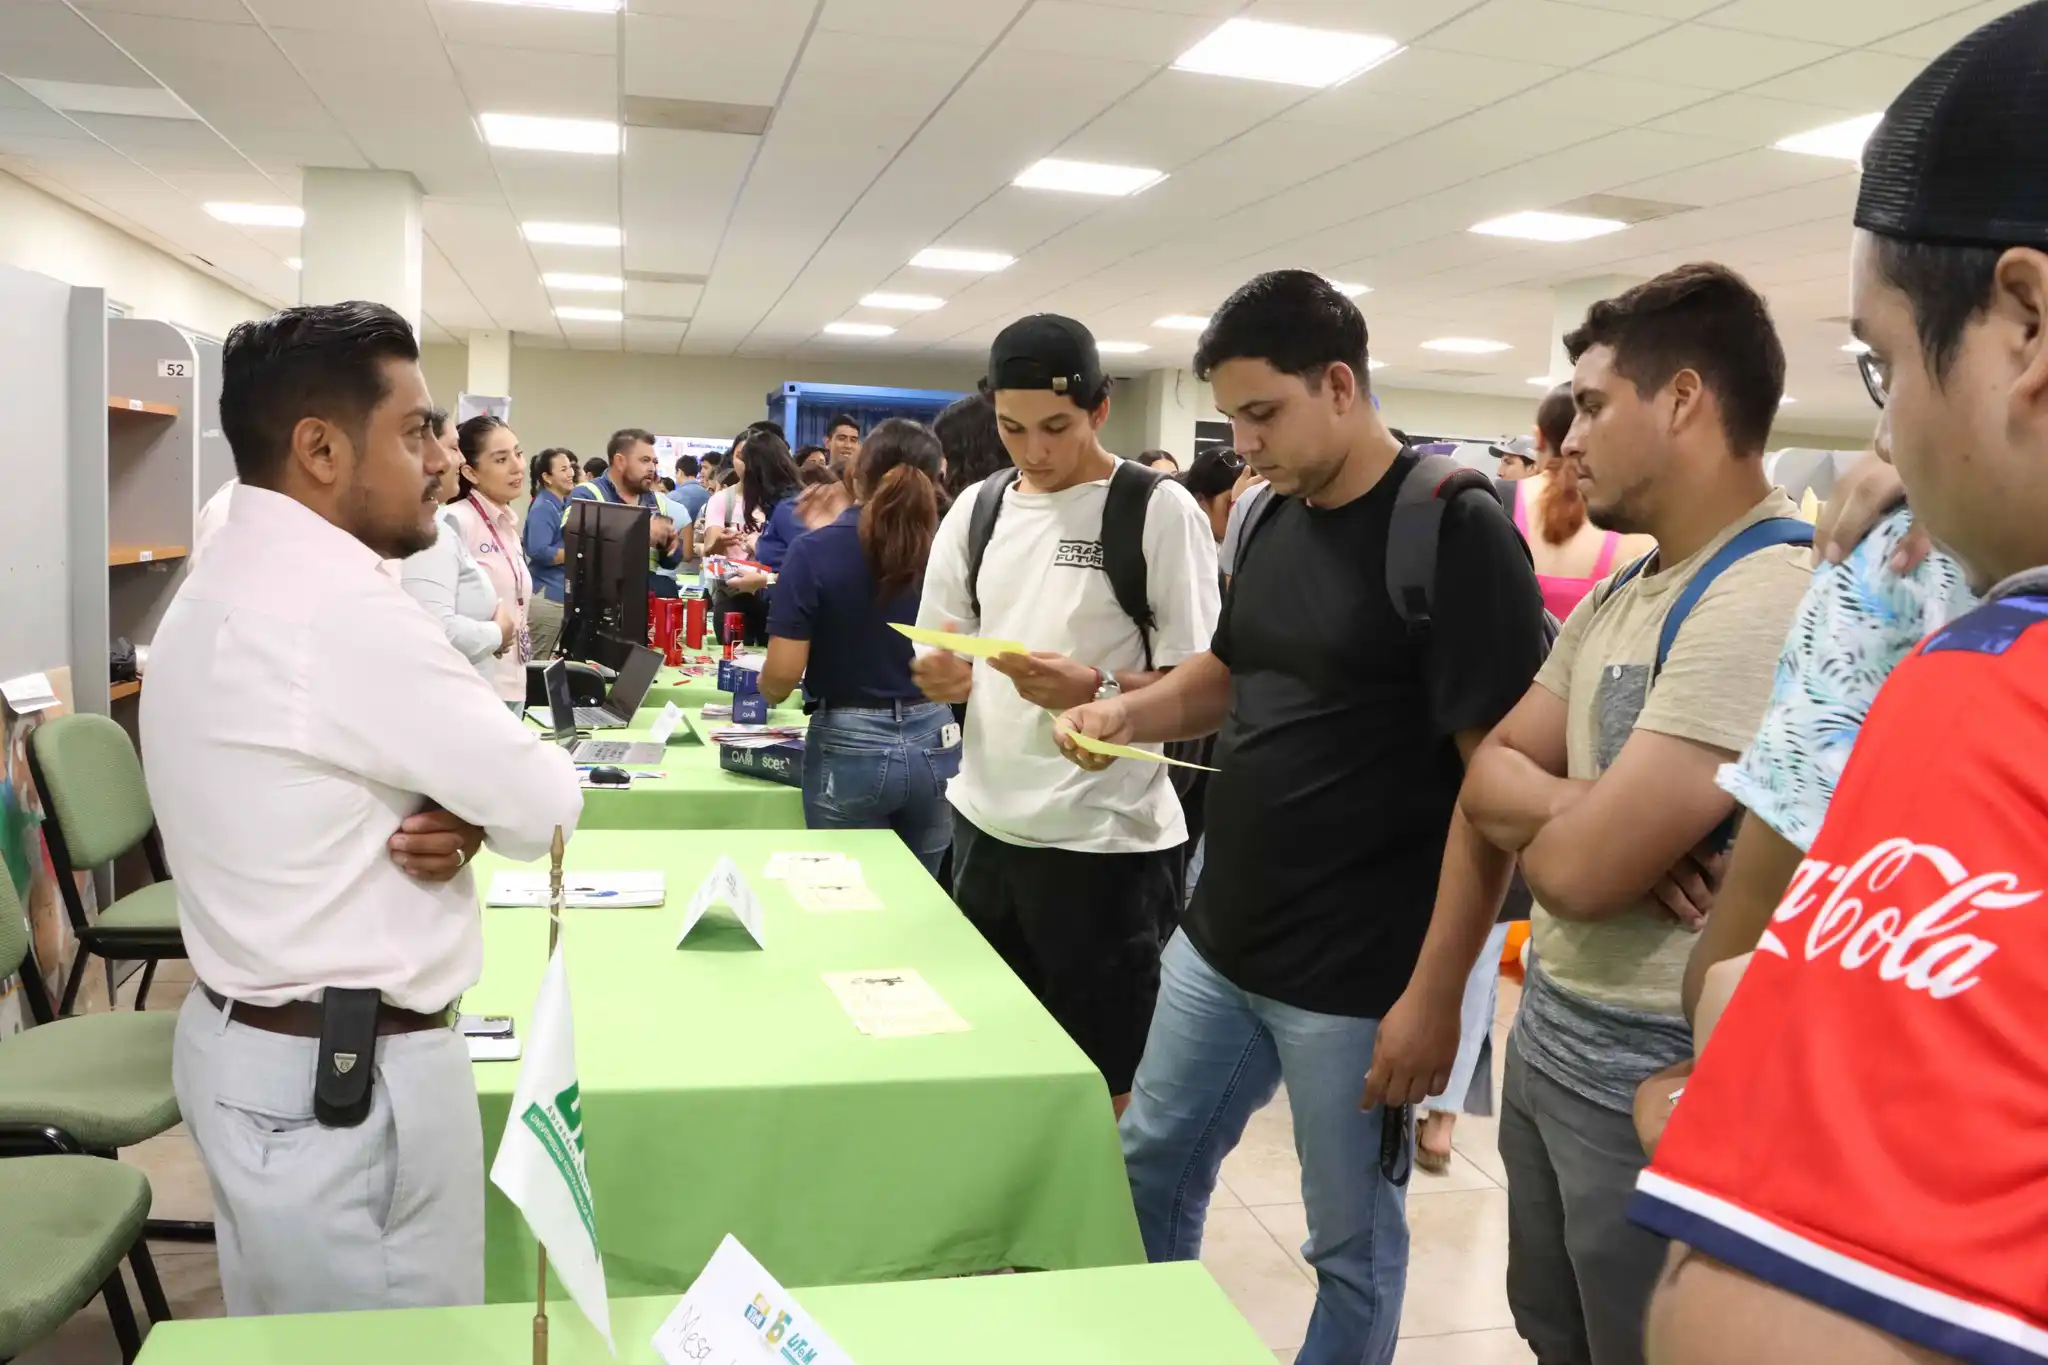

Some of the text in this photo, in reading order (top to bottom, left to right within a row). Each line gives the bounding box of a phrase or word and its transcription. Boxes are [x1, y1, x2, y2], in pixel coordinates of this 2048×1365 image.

[167, 364, 184, 376] 52
[1059, 545, 1103, 556] CRAZ
[1056, 554, 1102, 565] FUTUR
